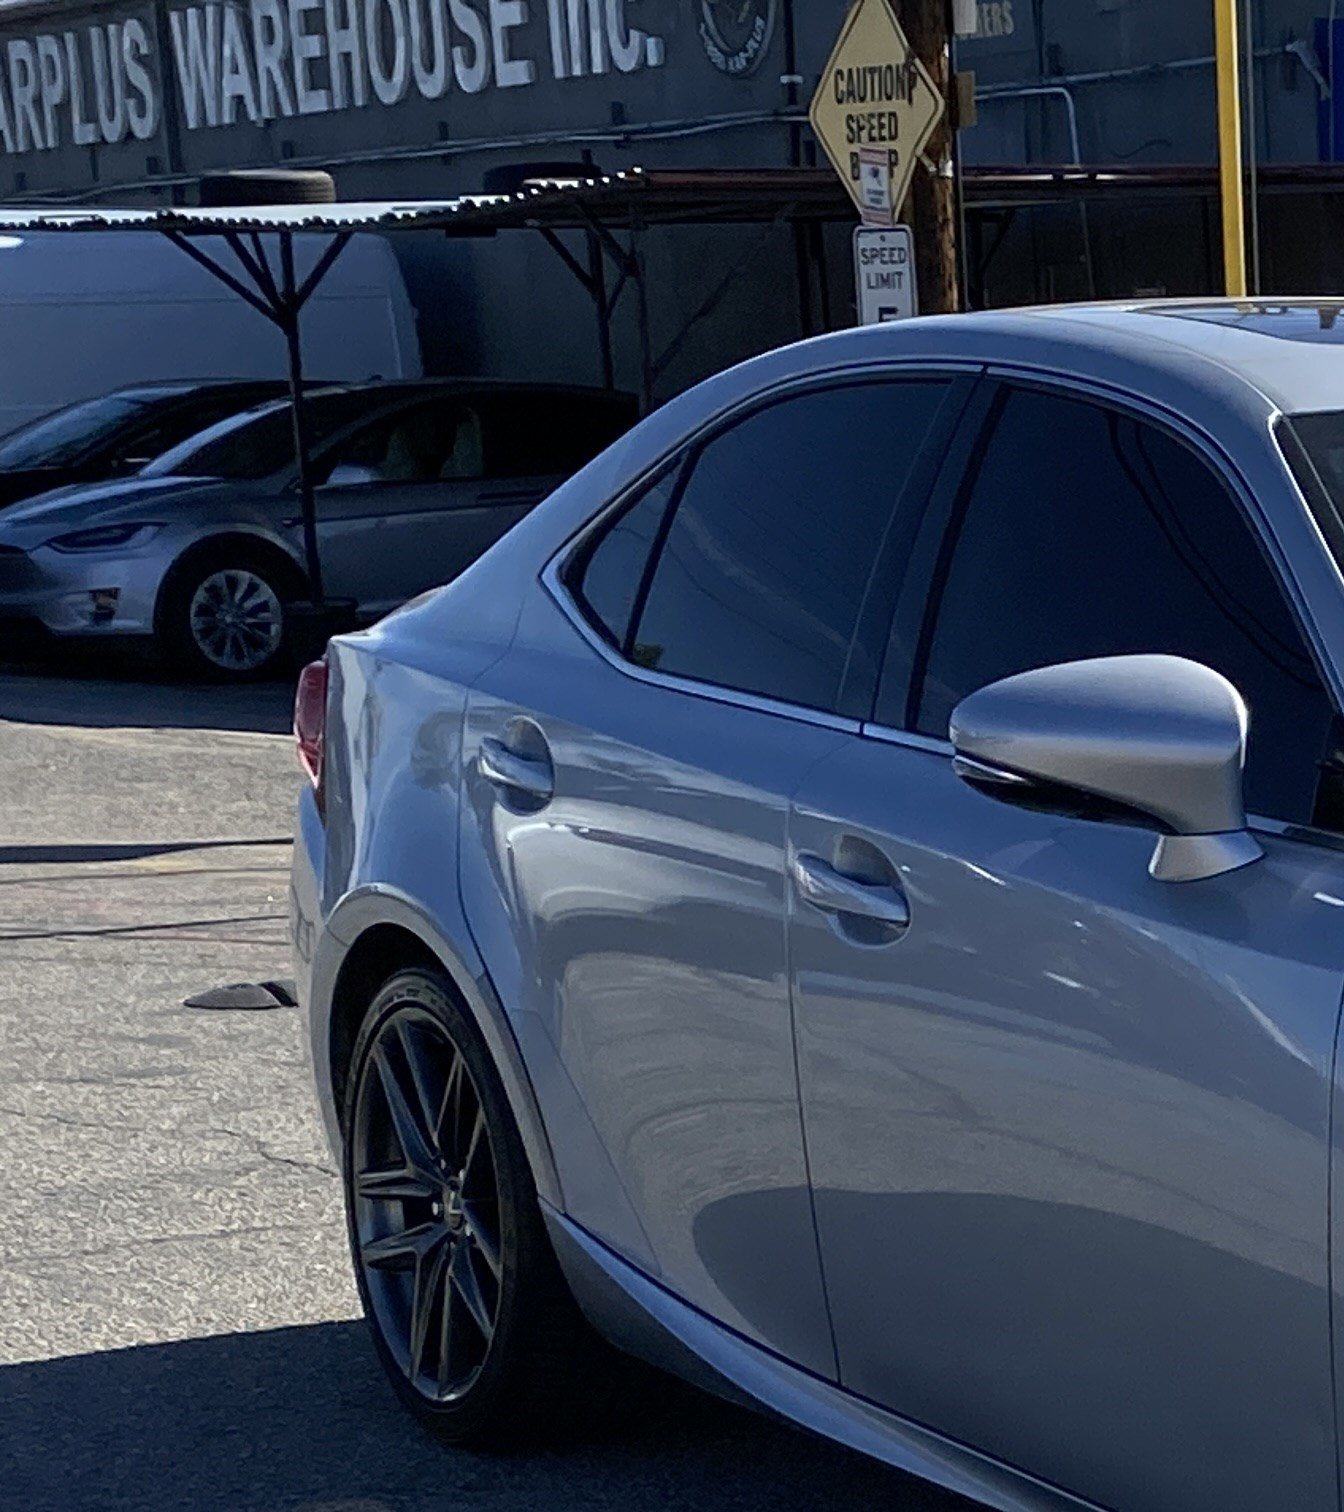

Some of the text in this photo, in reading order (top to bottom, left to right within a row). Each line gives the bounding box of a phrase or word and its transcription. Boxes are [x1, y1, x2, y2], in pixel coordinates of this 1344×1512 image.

[169, 0, 534, 130] WAREHOUSE
[846, 110, 898, 143] SPEED
[849, 148, 899, 180] BP
[860, 246, 907, 266] SPEED
[866, 271, 904, 290] LIMIT
